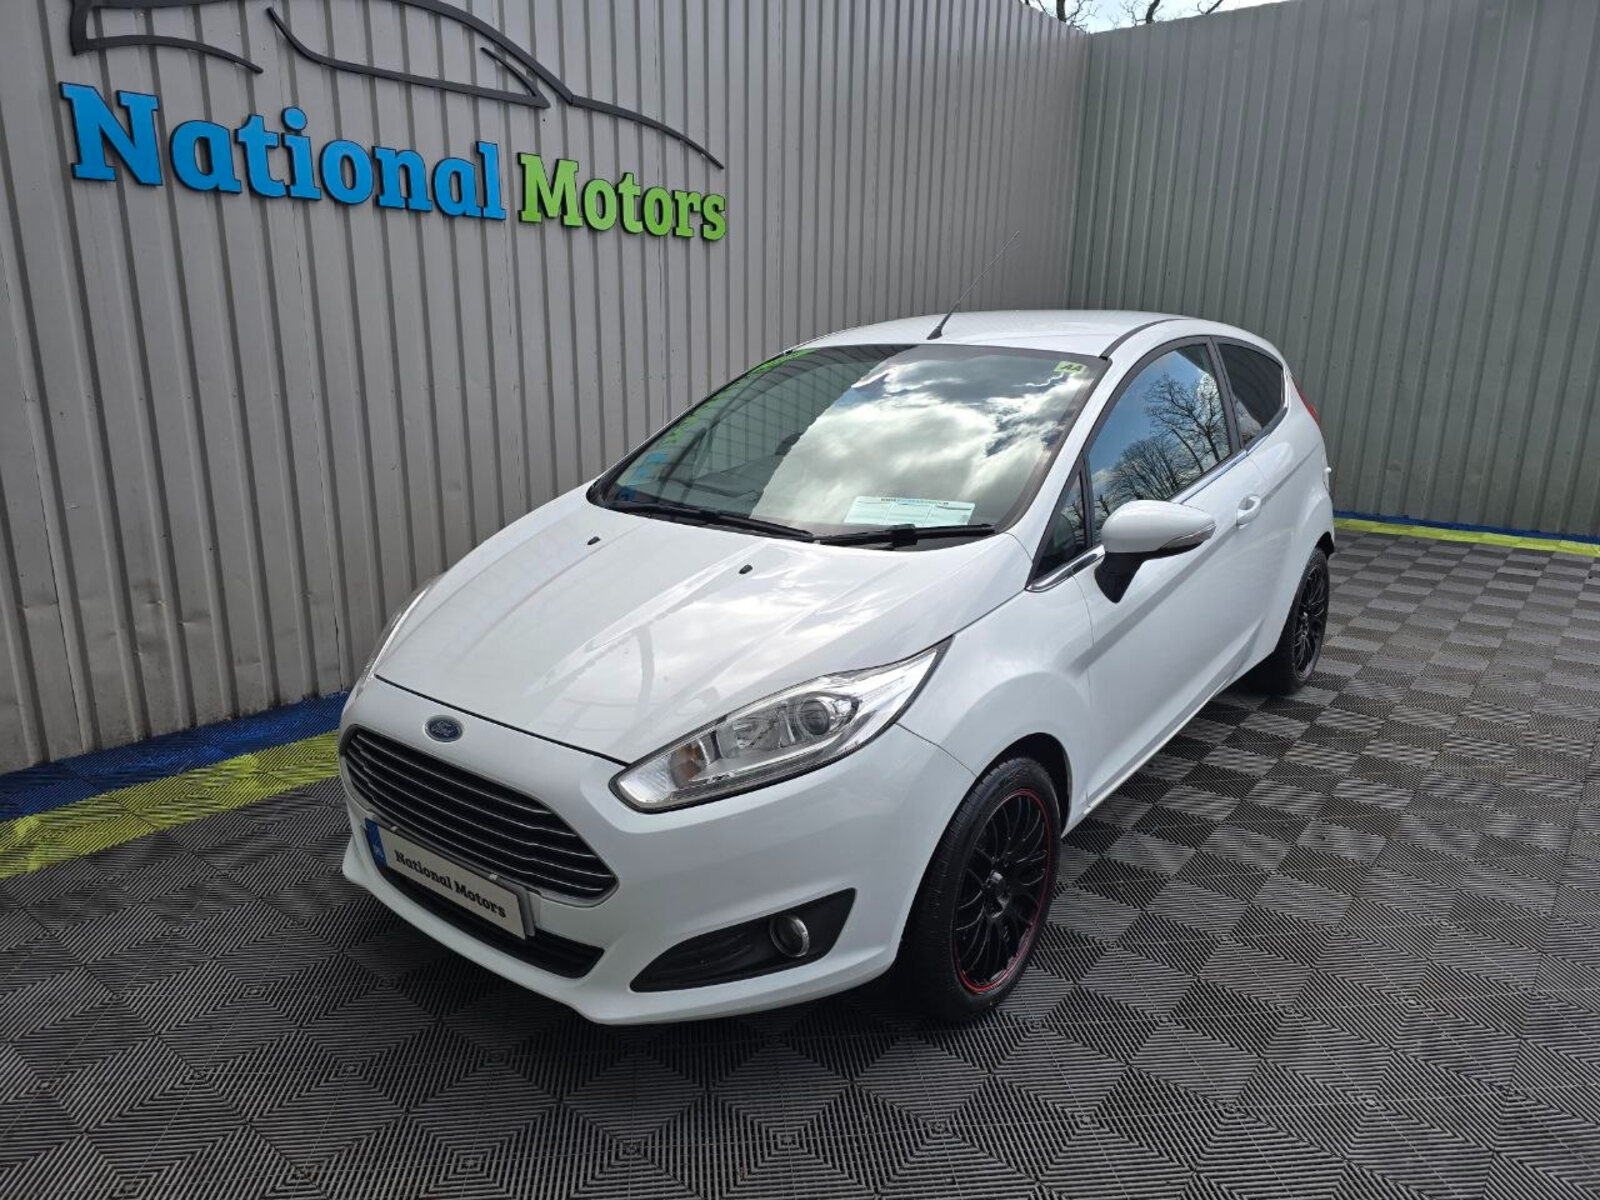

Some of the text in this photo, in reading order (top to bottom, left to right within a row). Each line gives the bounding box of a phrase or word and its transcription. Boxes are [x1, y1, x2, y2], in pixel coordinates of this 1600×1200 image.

[59, 82, 727, 242] National Motors
[394, 850, 506, 918] National Motors
